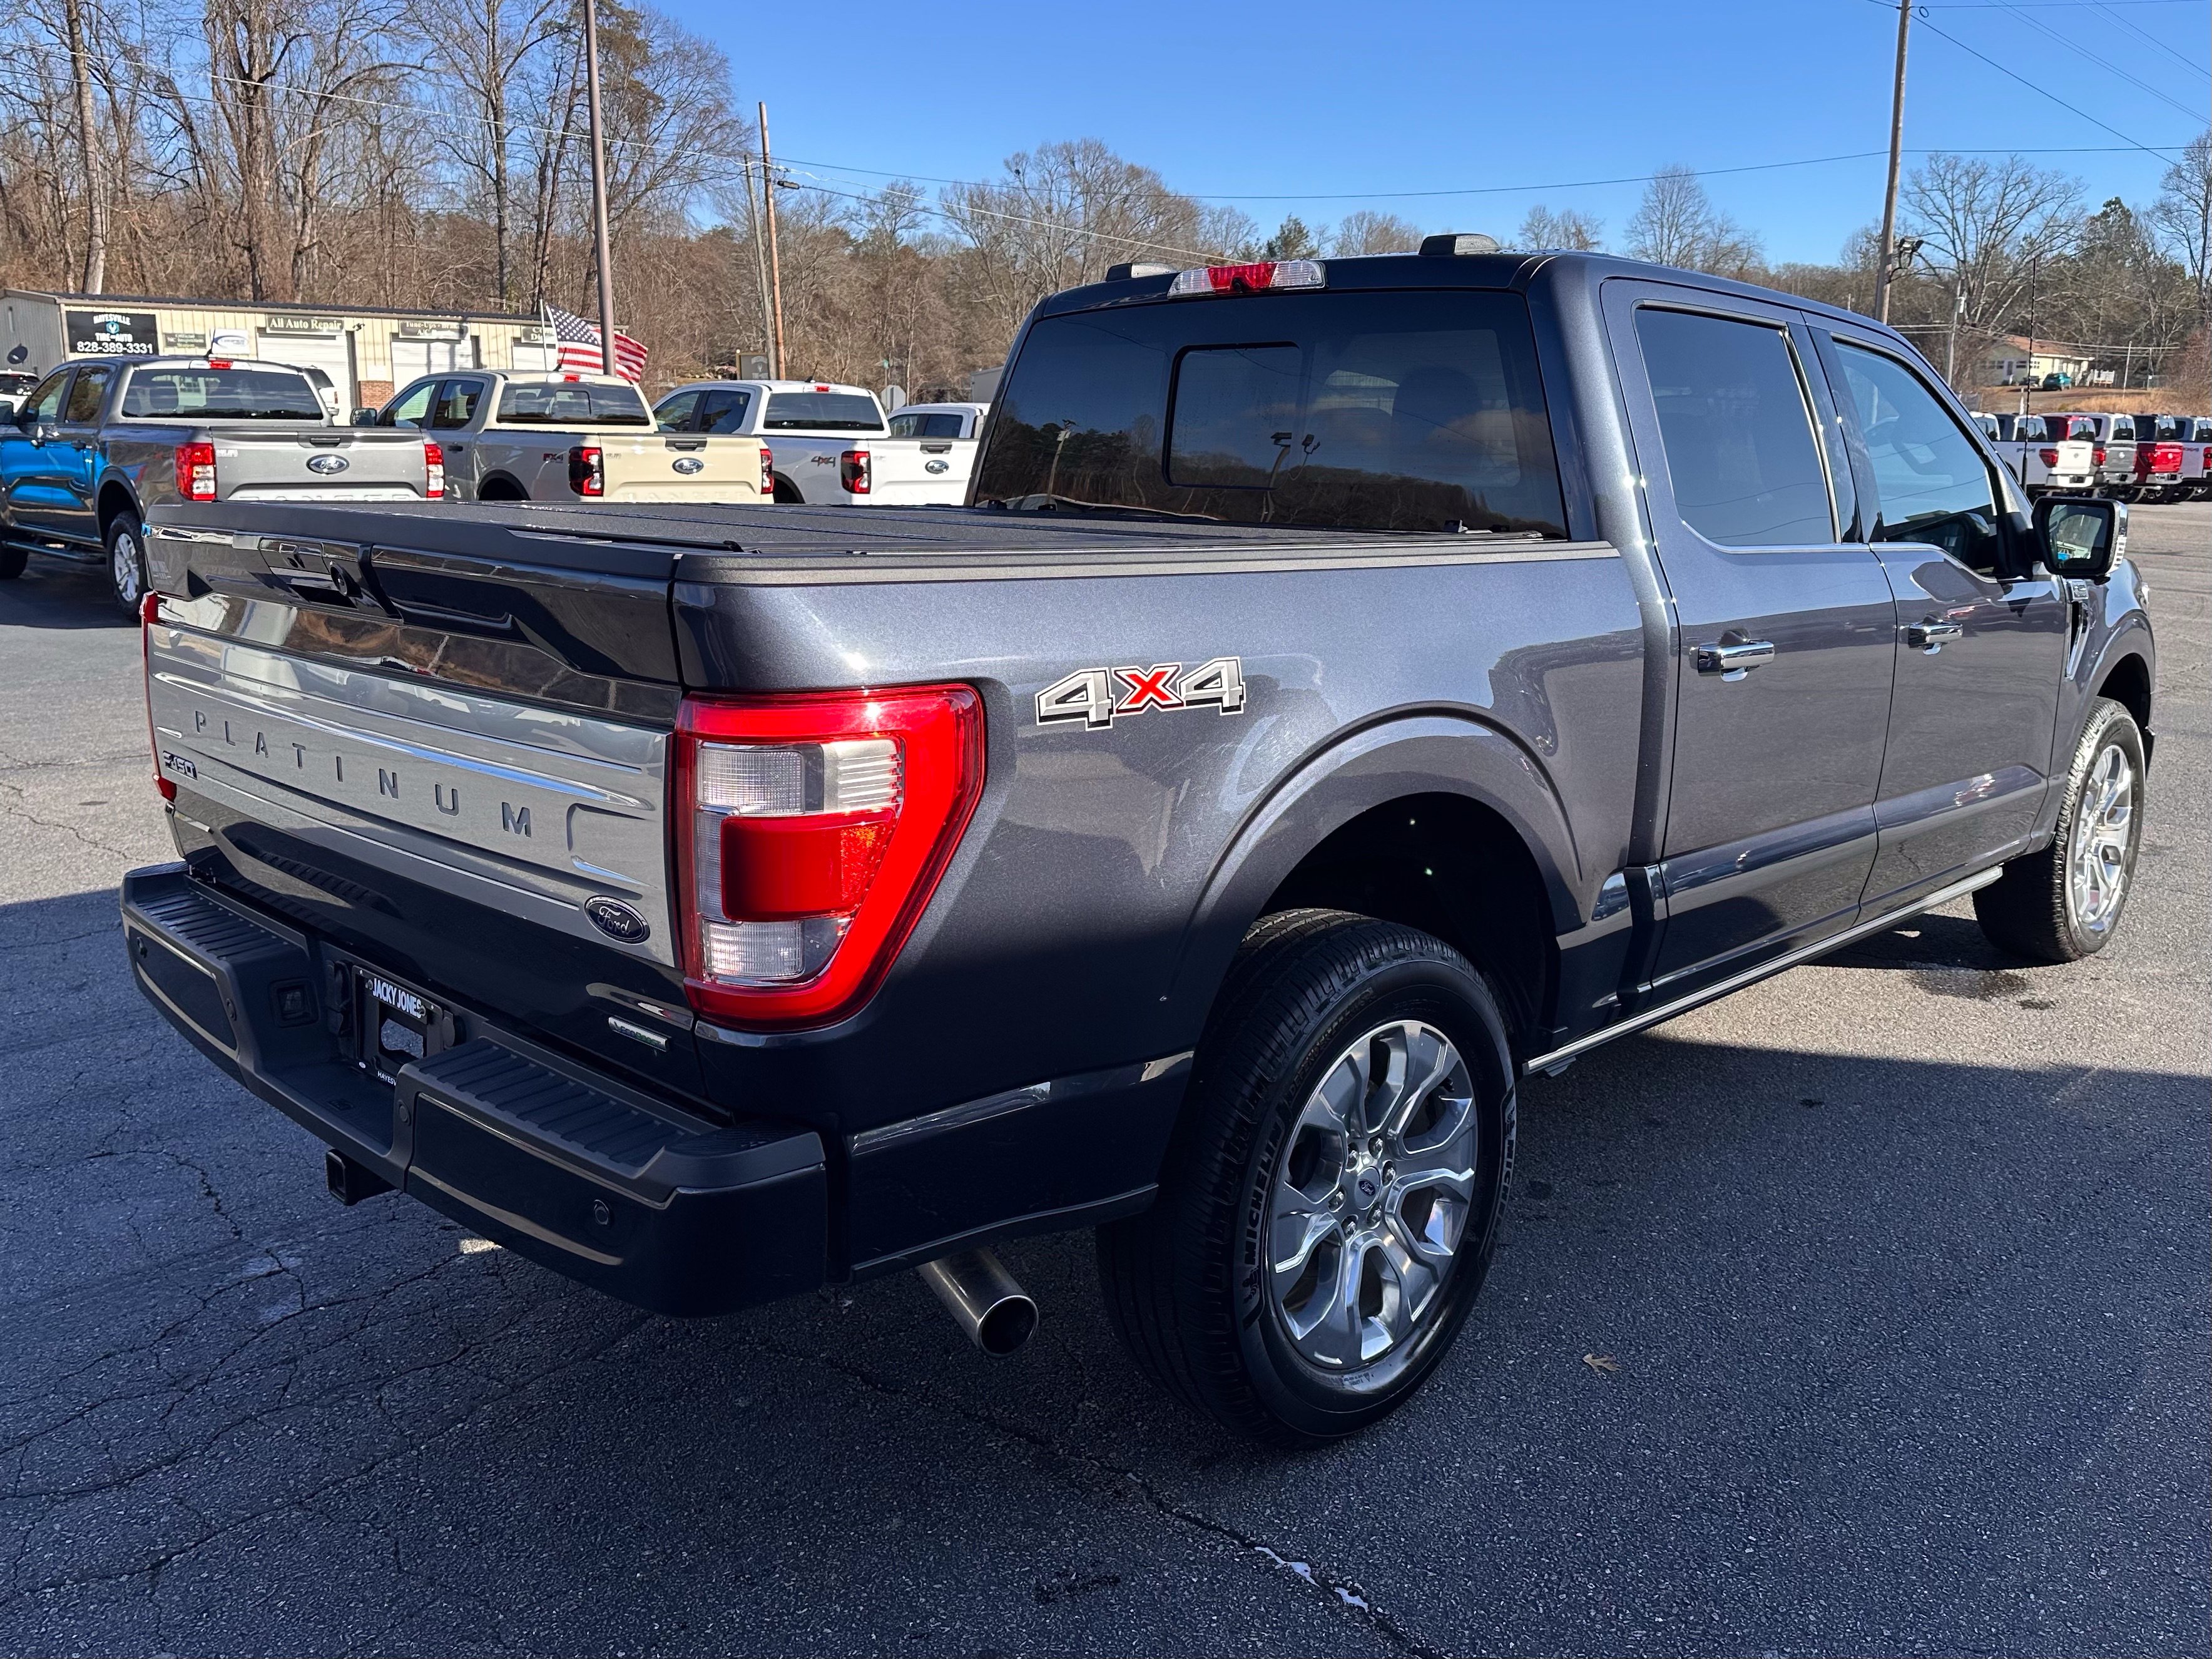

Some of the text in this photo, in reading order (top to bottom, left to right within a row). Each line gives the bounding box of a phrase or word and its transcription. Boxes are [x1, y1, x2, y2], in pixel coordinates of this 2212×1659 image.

[270, 317, 342, 331] All Auto Repair
[95, 332, 111, 342] TIRE
[115, 333, 133, 342] AUTO
[76, 341, 153, 354] 828-389-3331
[543, 453, 563, 461] FX4
[195, 711, 531, 837] PLATINUM
[598, 906, 631, 935] Ford
[372, 978, 422, 1019] JACKY JONES
[1243, 1120, 1281, 1266] MICHELIN
[1361, 1181, 1374, 1195] Ford
